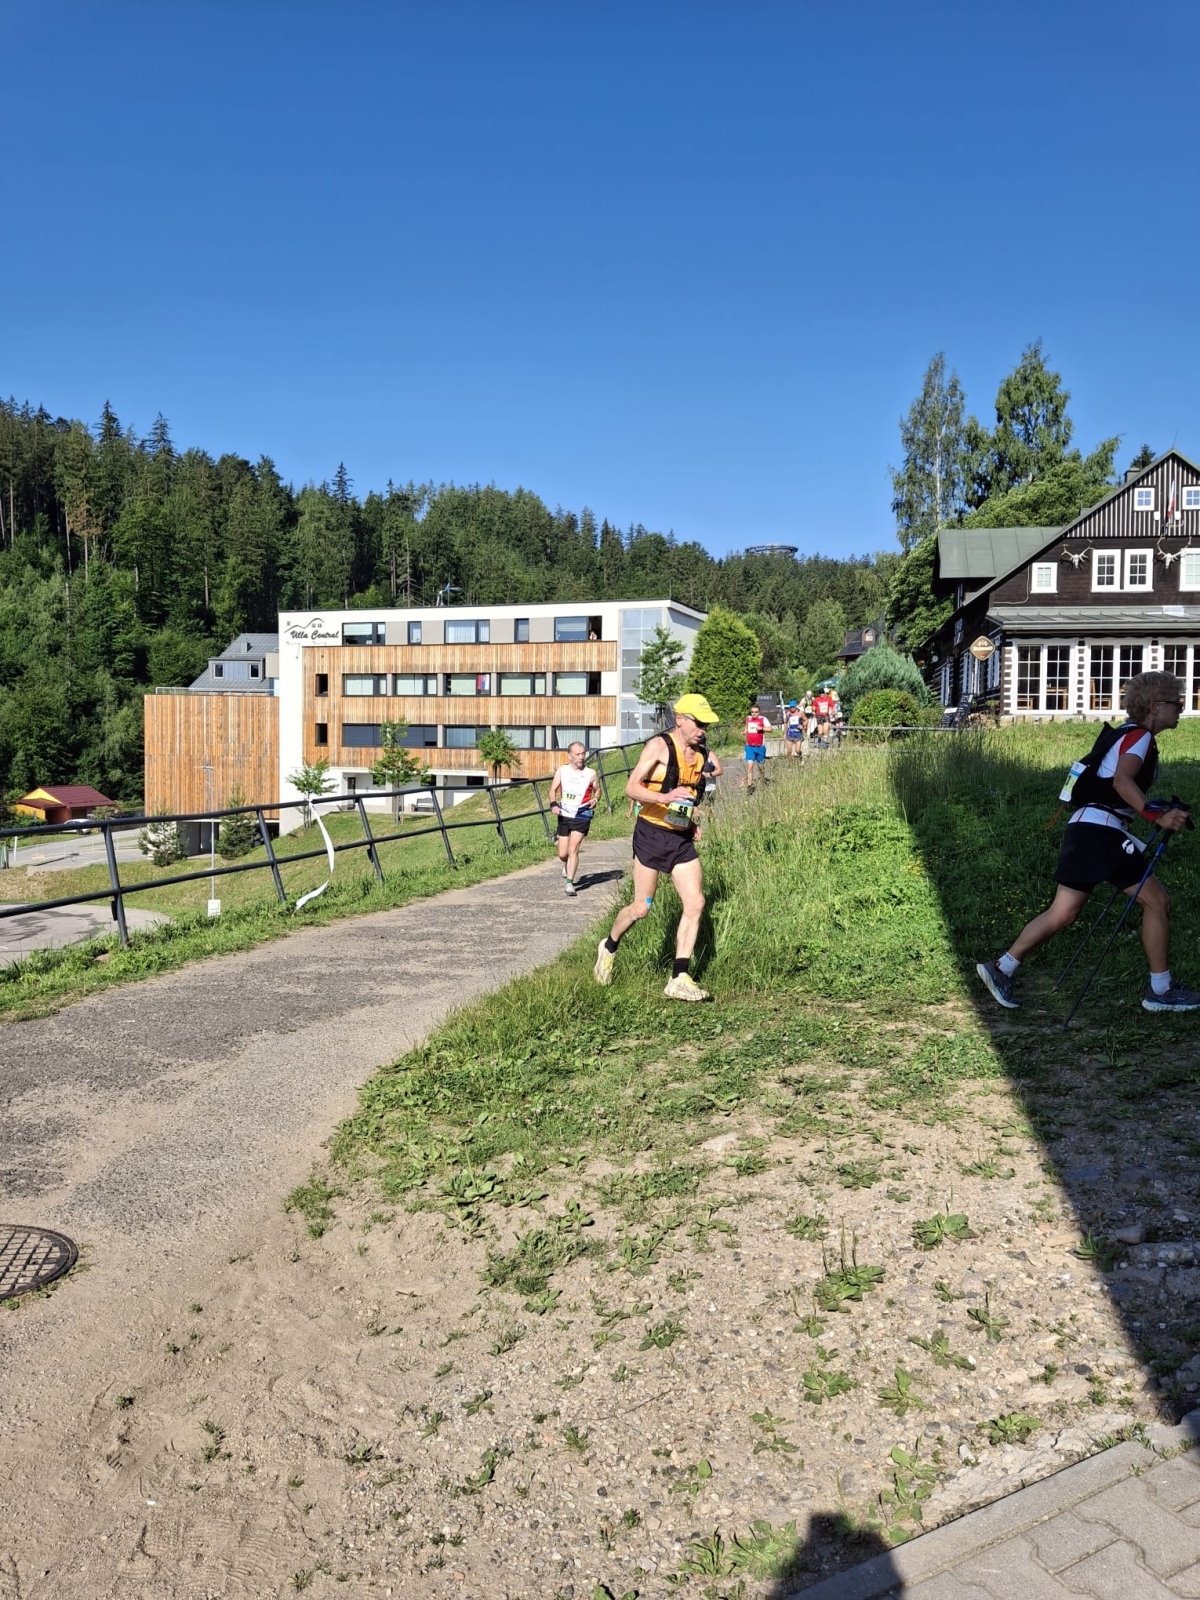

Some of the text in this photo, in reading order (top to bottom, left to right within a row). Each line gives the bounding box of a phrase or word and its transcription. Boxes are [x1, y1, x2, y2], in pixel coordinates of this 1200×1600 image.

[290, 630, 339, 640] Villa Central
[678, 805, 688, 816] 58
